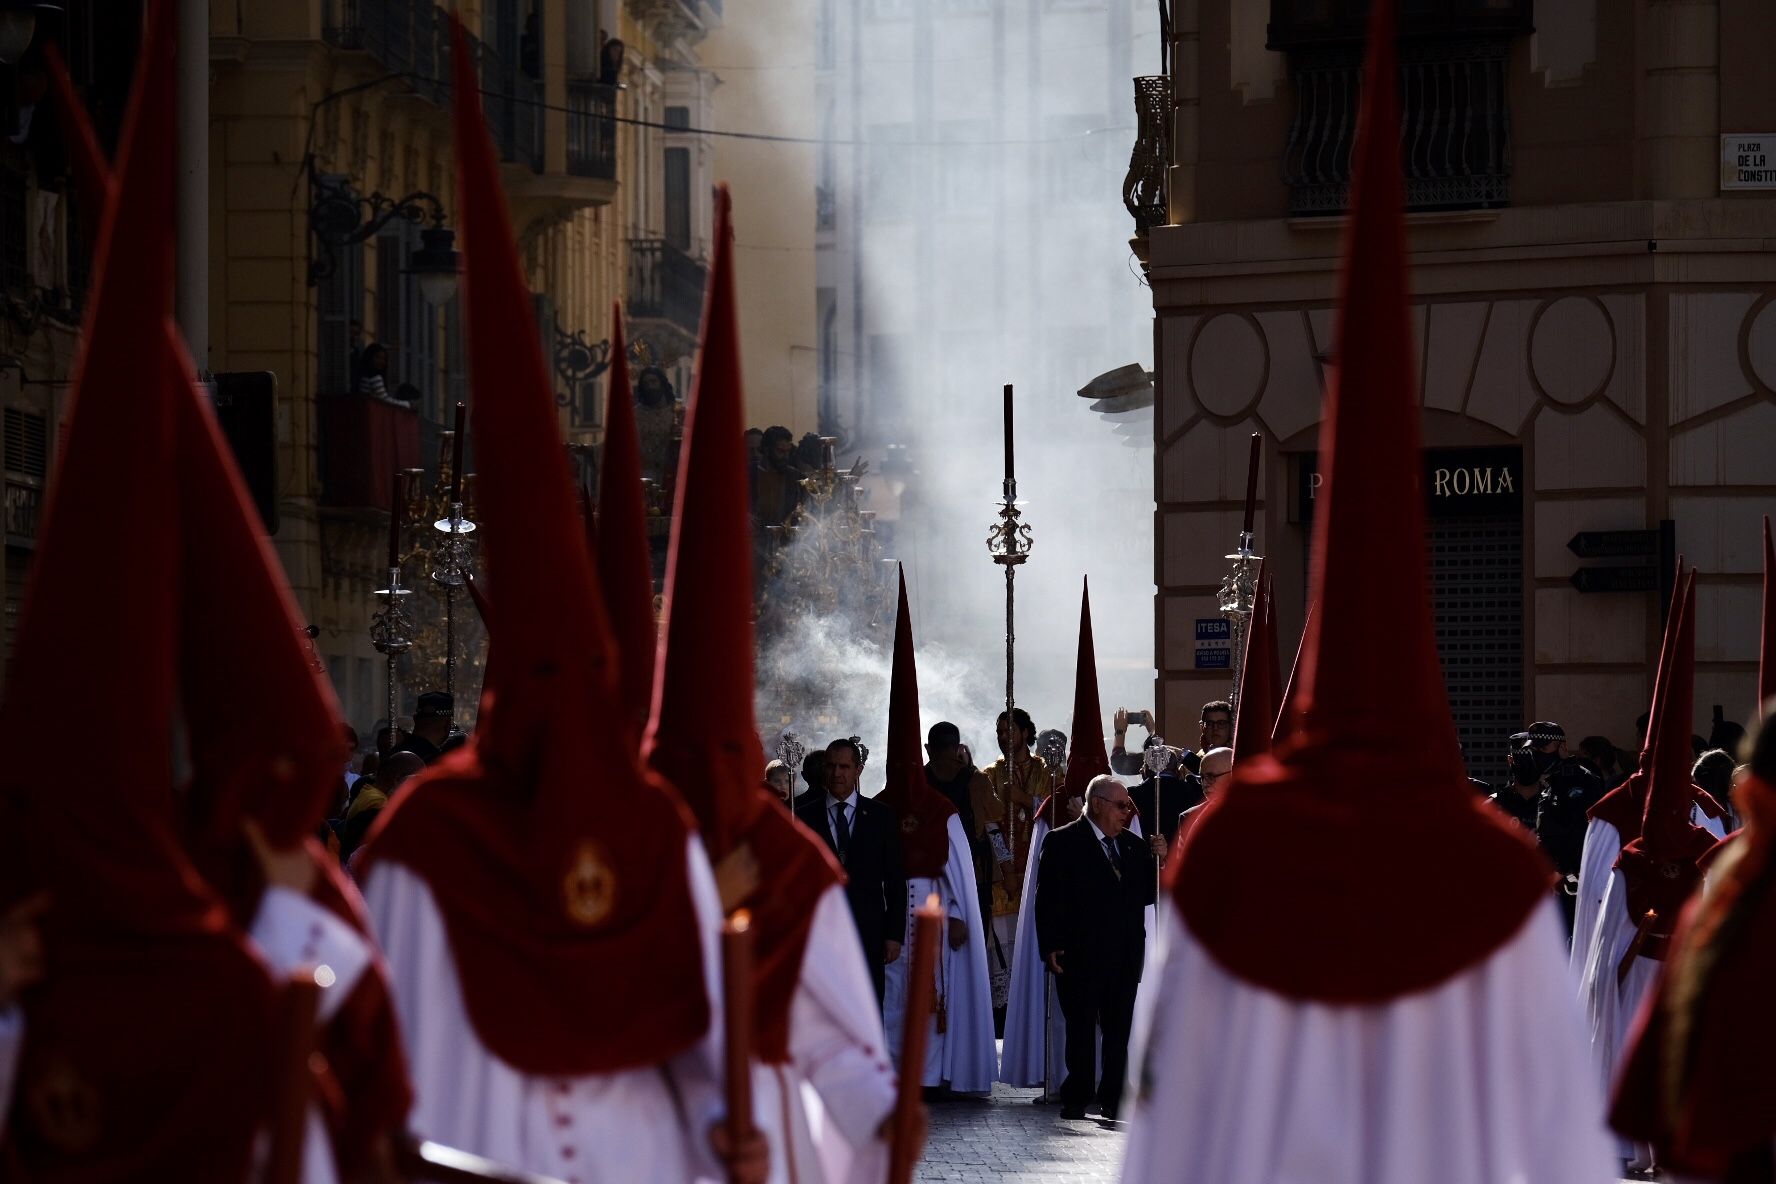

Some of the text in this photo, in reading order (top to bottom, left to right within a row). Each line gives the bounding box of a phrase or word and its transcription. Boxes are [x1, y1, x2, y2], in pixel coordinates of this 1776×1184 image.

[1738, 143, 1760, 152] PLAZA
[1738, 155, 1765, 166] DE LA
[1434, 467, 1514, 497] ROMA
[1198, 622, 1228, 632] ITESA
